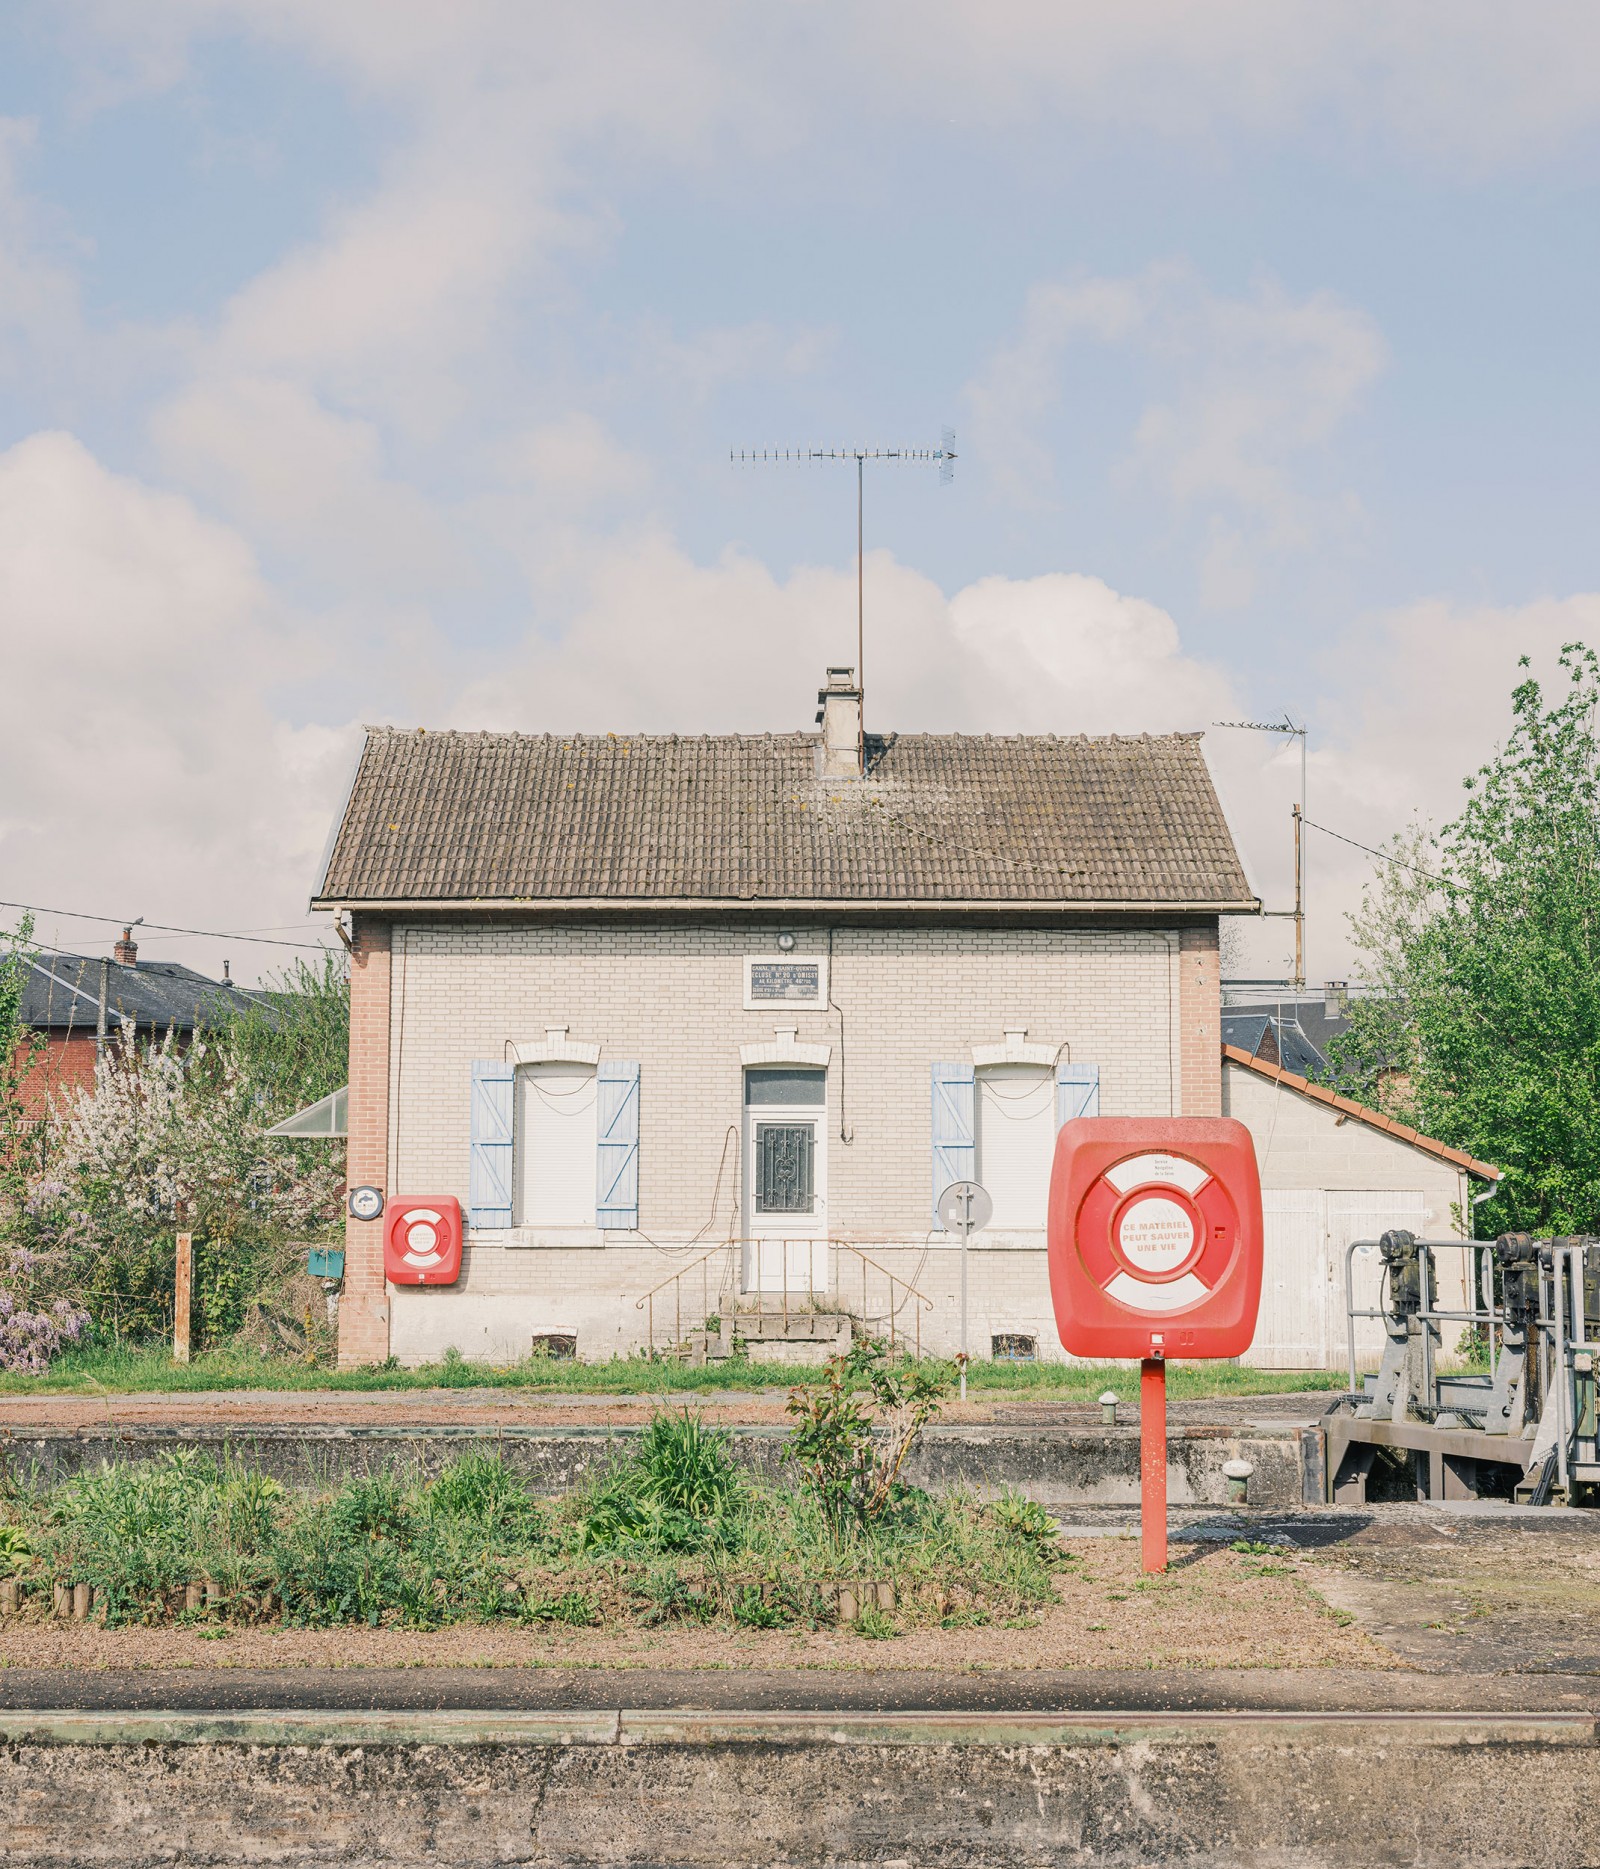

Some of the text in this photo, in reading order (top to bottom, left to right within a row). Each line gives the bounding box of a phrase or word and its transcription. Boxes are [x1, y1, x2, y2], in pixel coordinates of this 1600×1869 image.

[1123, 1232, 1190, 1242] PEUT SAUVER
[1137, 1243, 1177, 1252] UNE VIE
